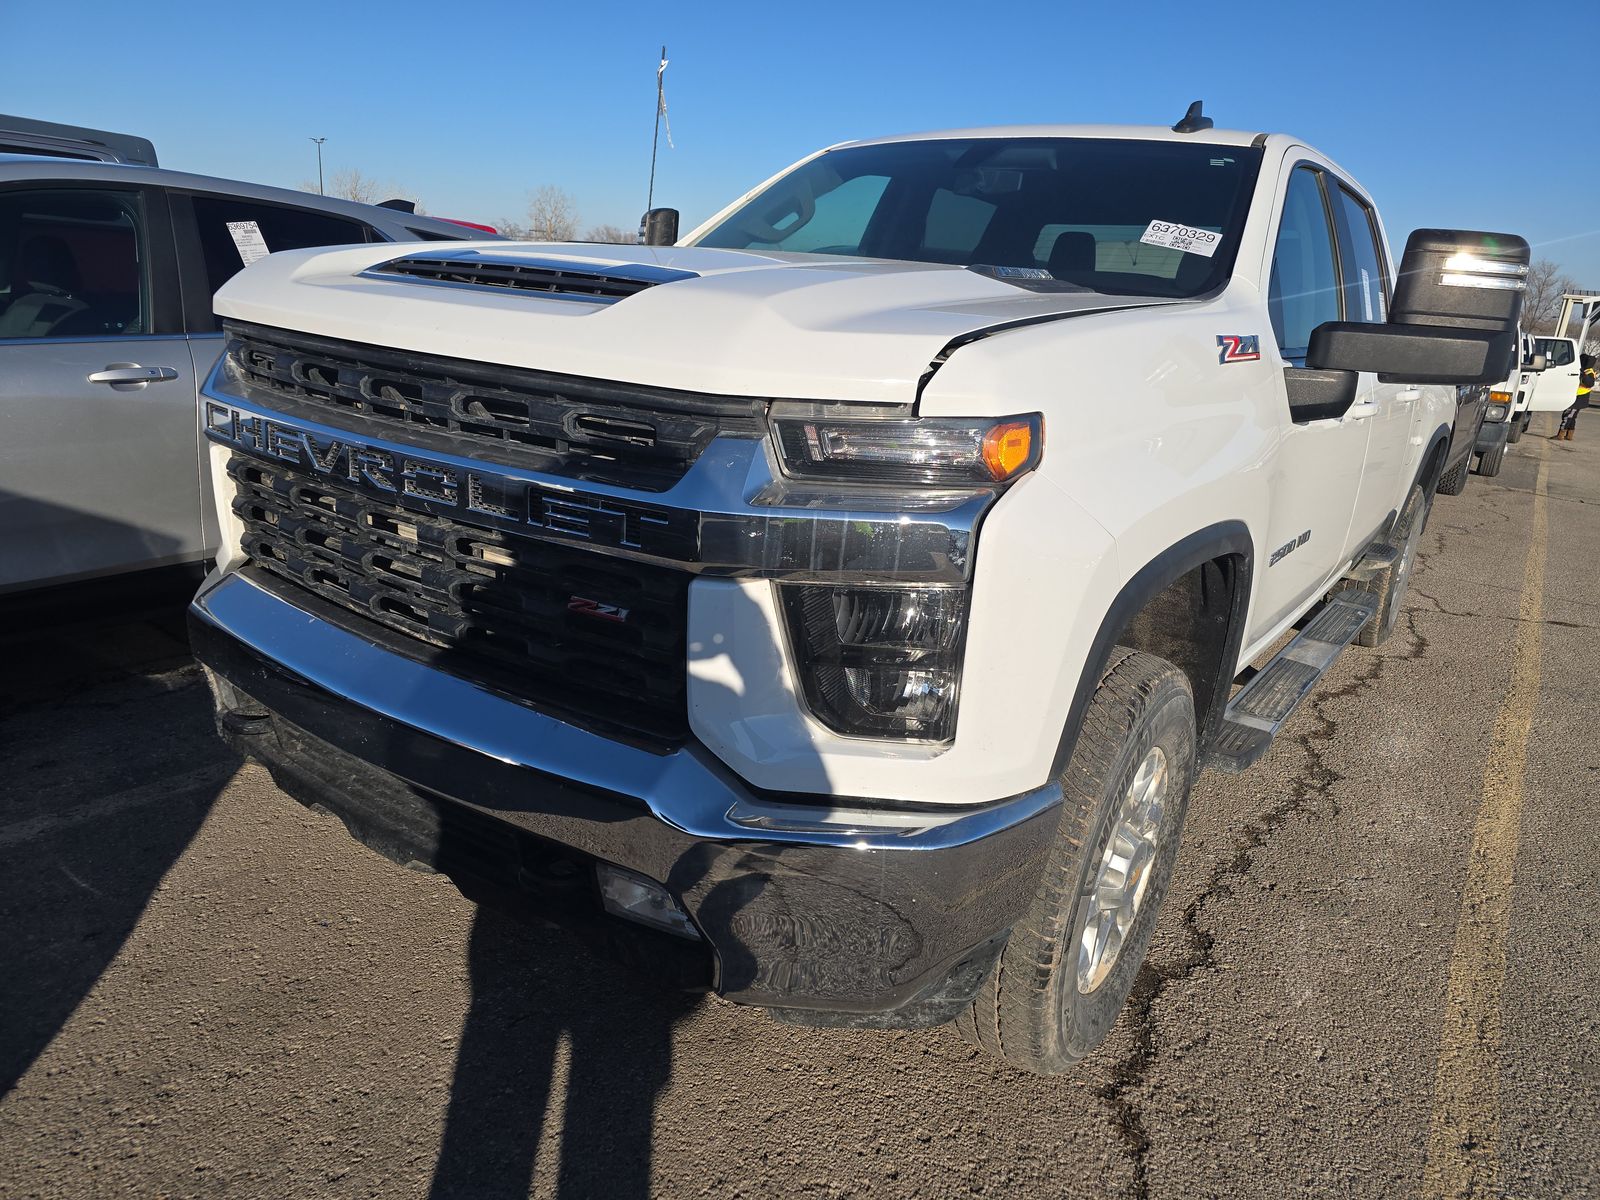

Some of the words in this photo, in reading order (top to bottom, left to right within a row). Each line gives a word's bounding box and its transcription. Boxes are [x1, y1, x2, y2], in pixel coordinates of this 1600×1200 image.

[1151, 222, 1216, 243] 6370329
[1216, 335, 1260, 365] Z71
[206, 402, 668, 549] CHEVROLET
